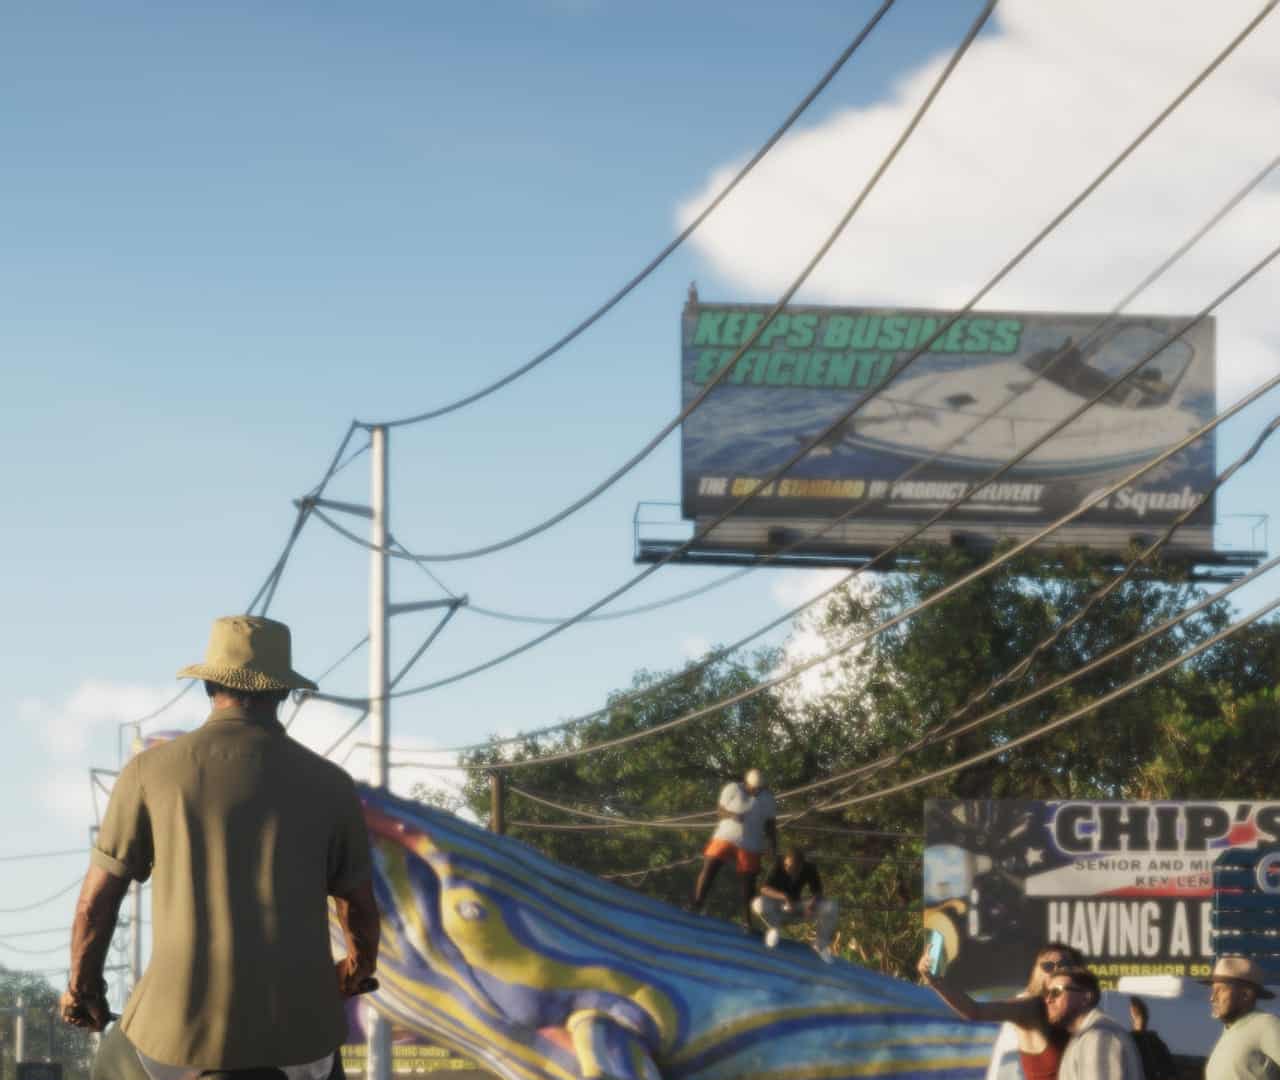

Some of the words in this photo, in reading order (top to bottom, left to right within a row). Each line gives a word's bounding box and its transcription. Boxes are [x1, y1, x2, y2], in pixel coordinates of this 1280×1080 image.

[693, 311, 819, 347] KEEPS
[822, 314, 1022, 353] BUSINESS
[693, 350, 894, 387] EFFICIENT!
[699, 477, 729, 496] THE
[1075, 858, 1142, 872] SENIOR
[1148, 858, 1184, 872] AND
[1135, 876, 1170, 890] KEY
[1047, 901, 1161, 957] HAVING
[1169, 901, 1192, 957] A
